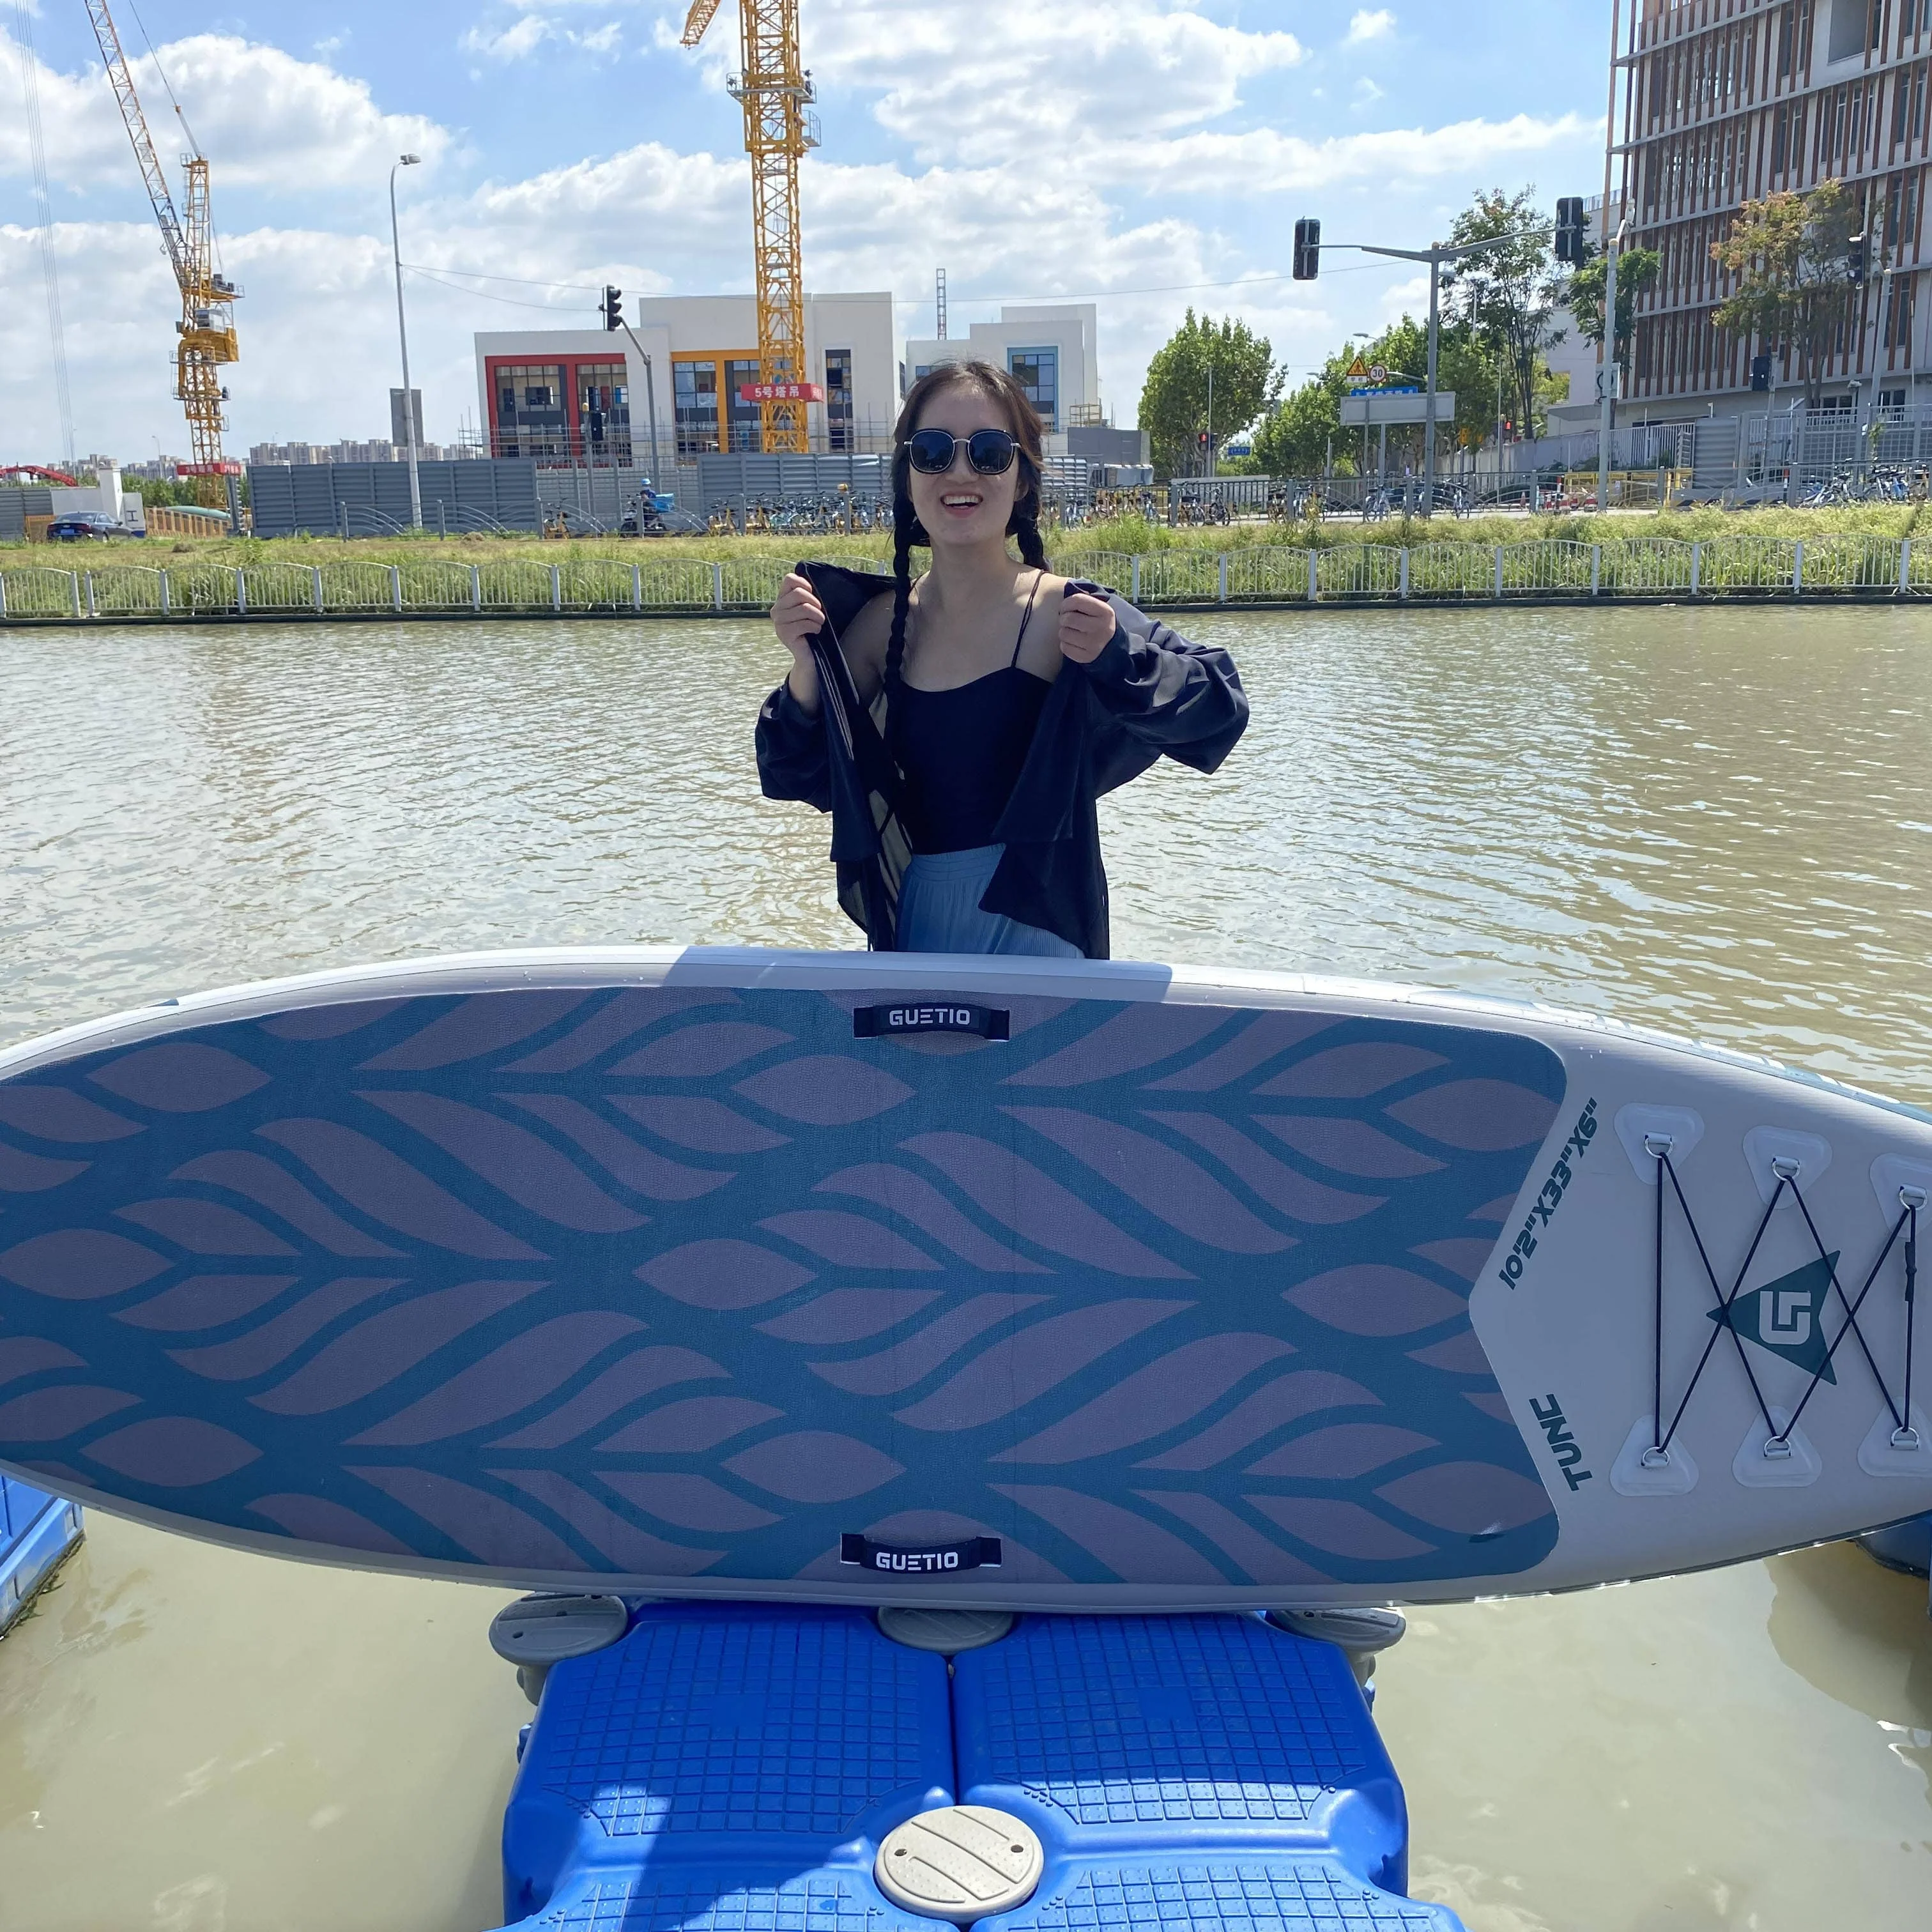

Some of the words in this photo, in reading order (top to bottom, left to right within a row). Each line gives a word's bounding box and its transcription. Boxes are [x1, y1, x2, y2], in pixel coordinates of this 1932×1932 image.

[1372, 369, 1383, 378] 30
[755, 385, 800, 398] 5号塔吊
[889, 1008, 970, 1025] GUETIO
[875, 1551, 958, 1571] GUETIO
